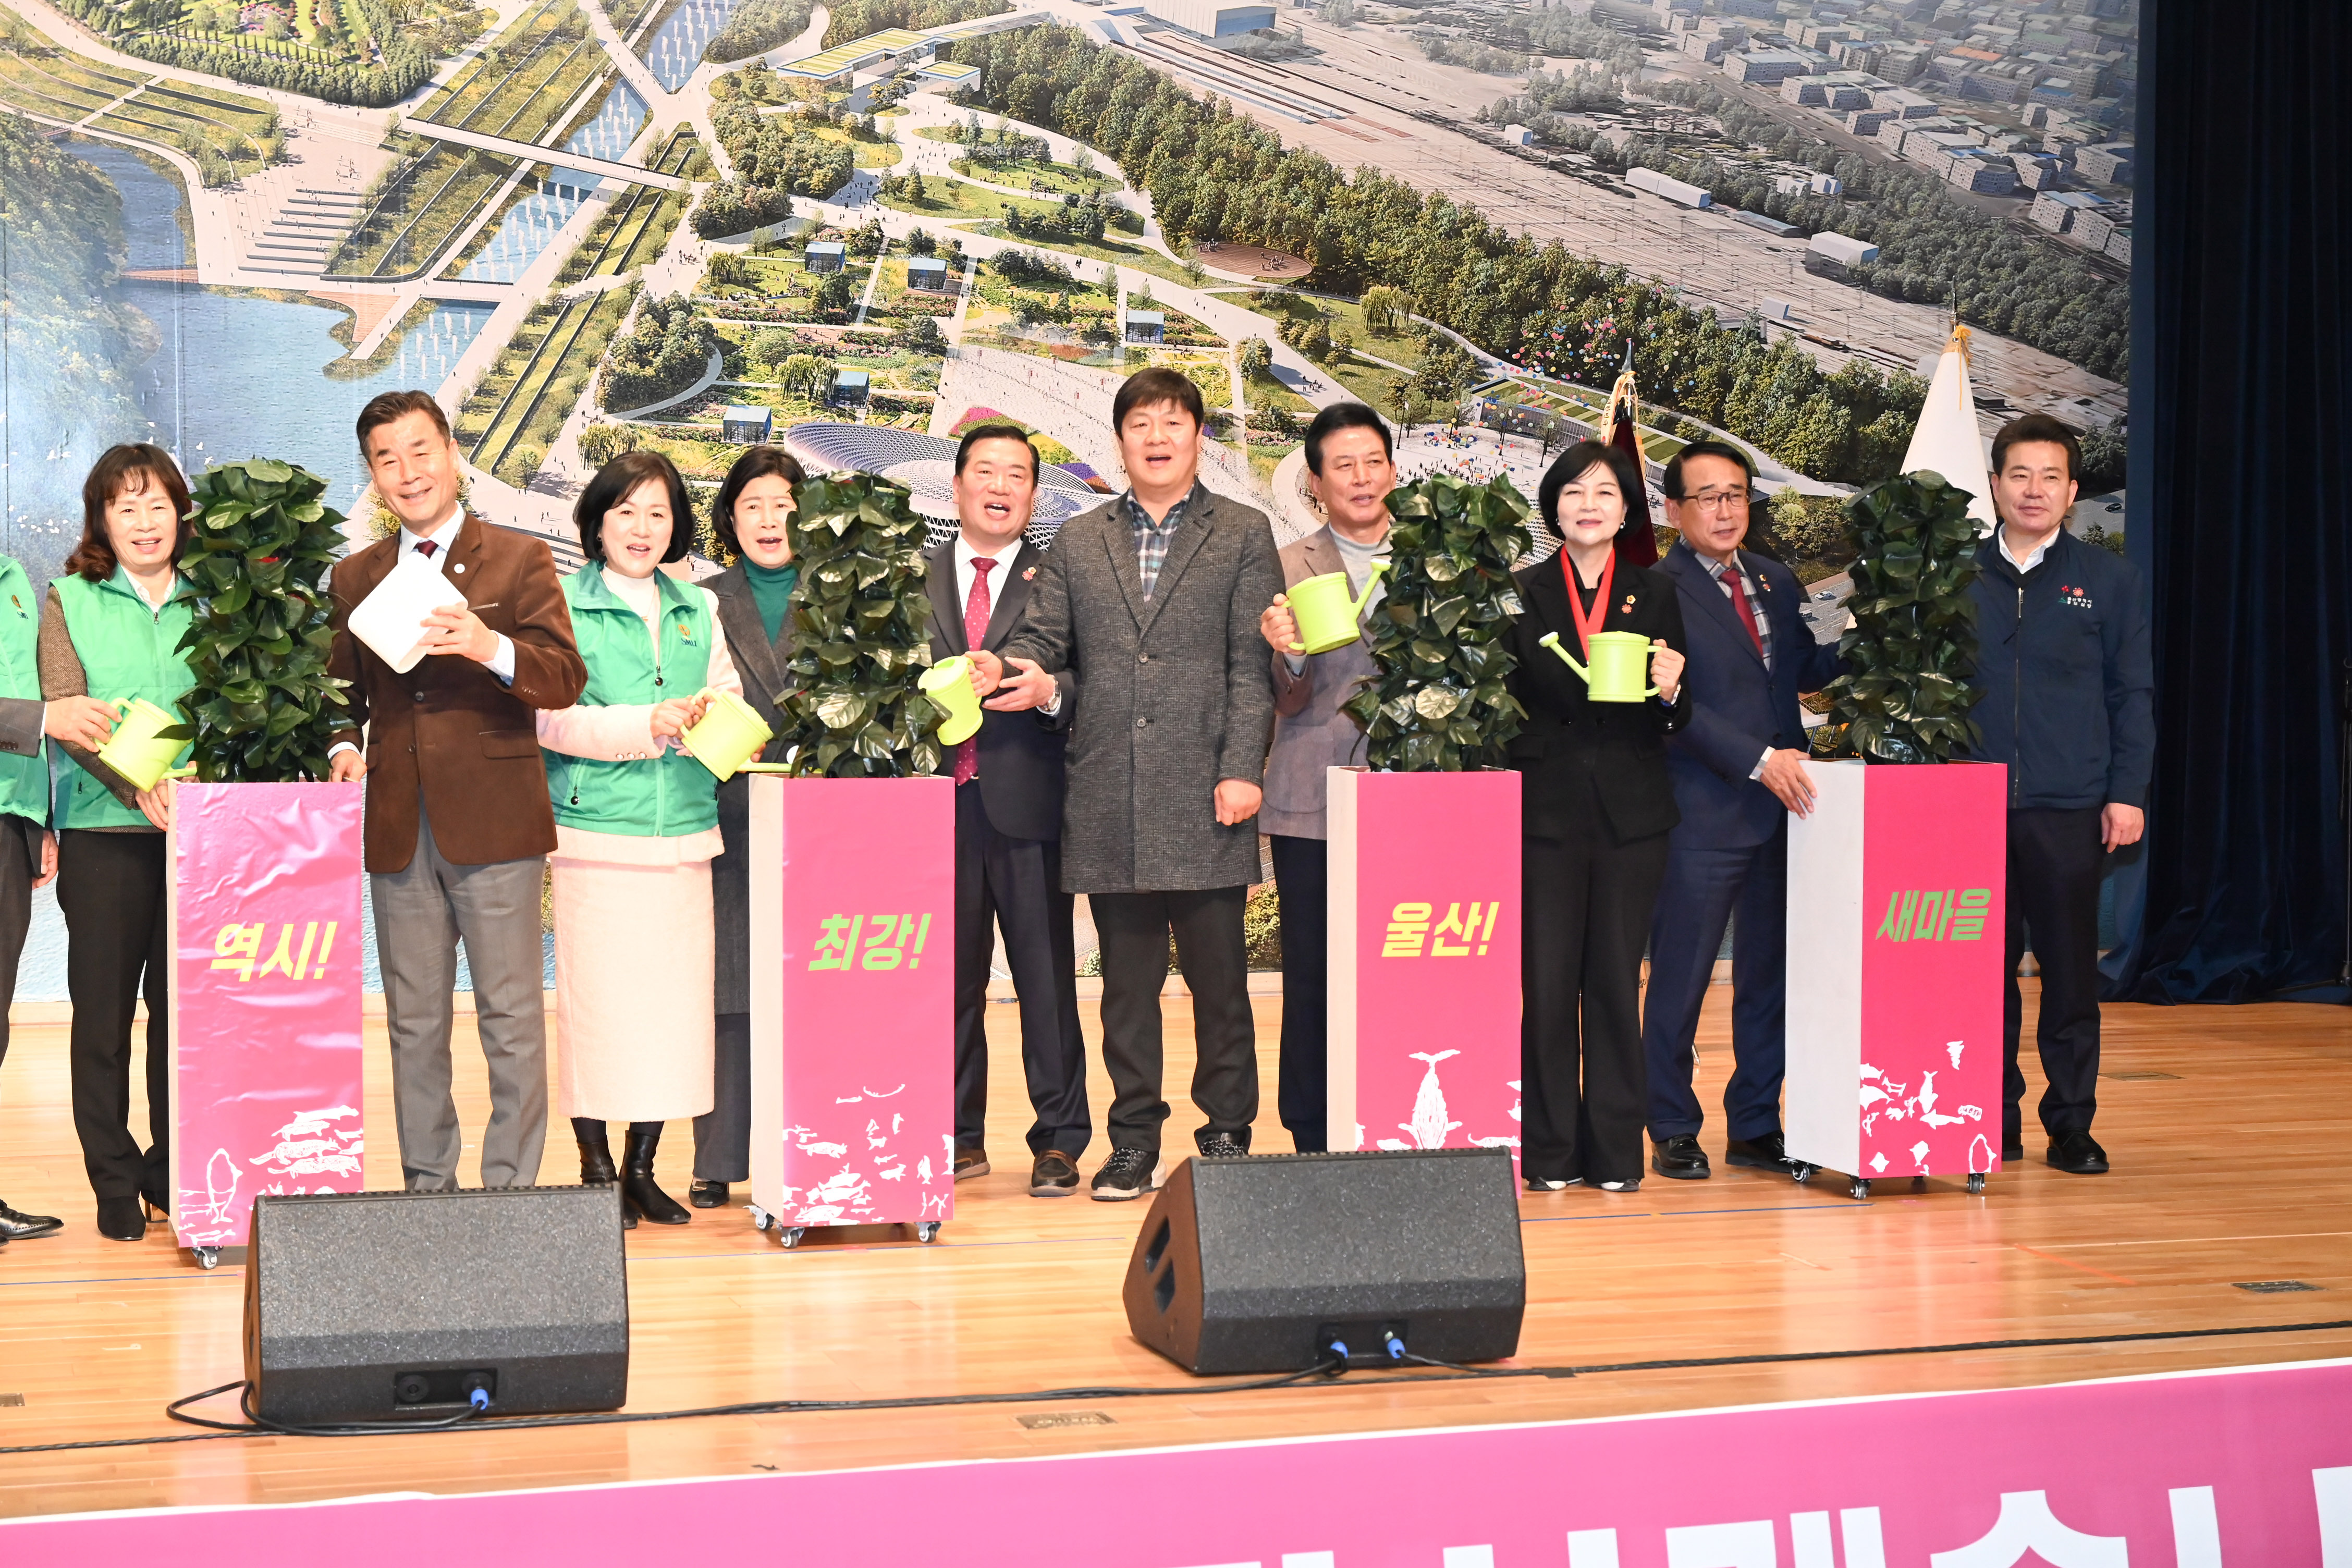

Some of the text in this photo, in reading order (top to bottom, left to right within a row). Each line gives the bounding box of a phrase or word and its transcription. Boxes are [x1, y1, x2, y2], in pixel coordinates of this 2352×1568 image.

[681, 638, 697, 647] SMU
[808, 913, 932, 971] 최강!
[1382, 901, 1500, 958] 울산!
[1876, 888, 1992, 942] 새마을
[211, 922, 337, 982] 역시!
